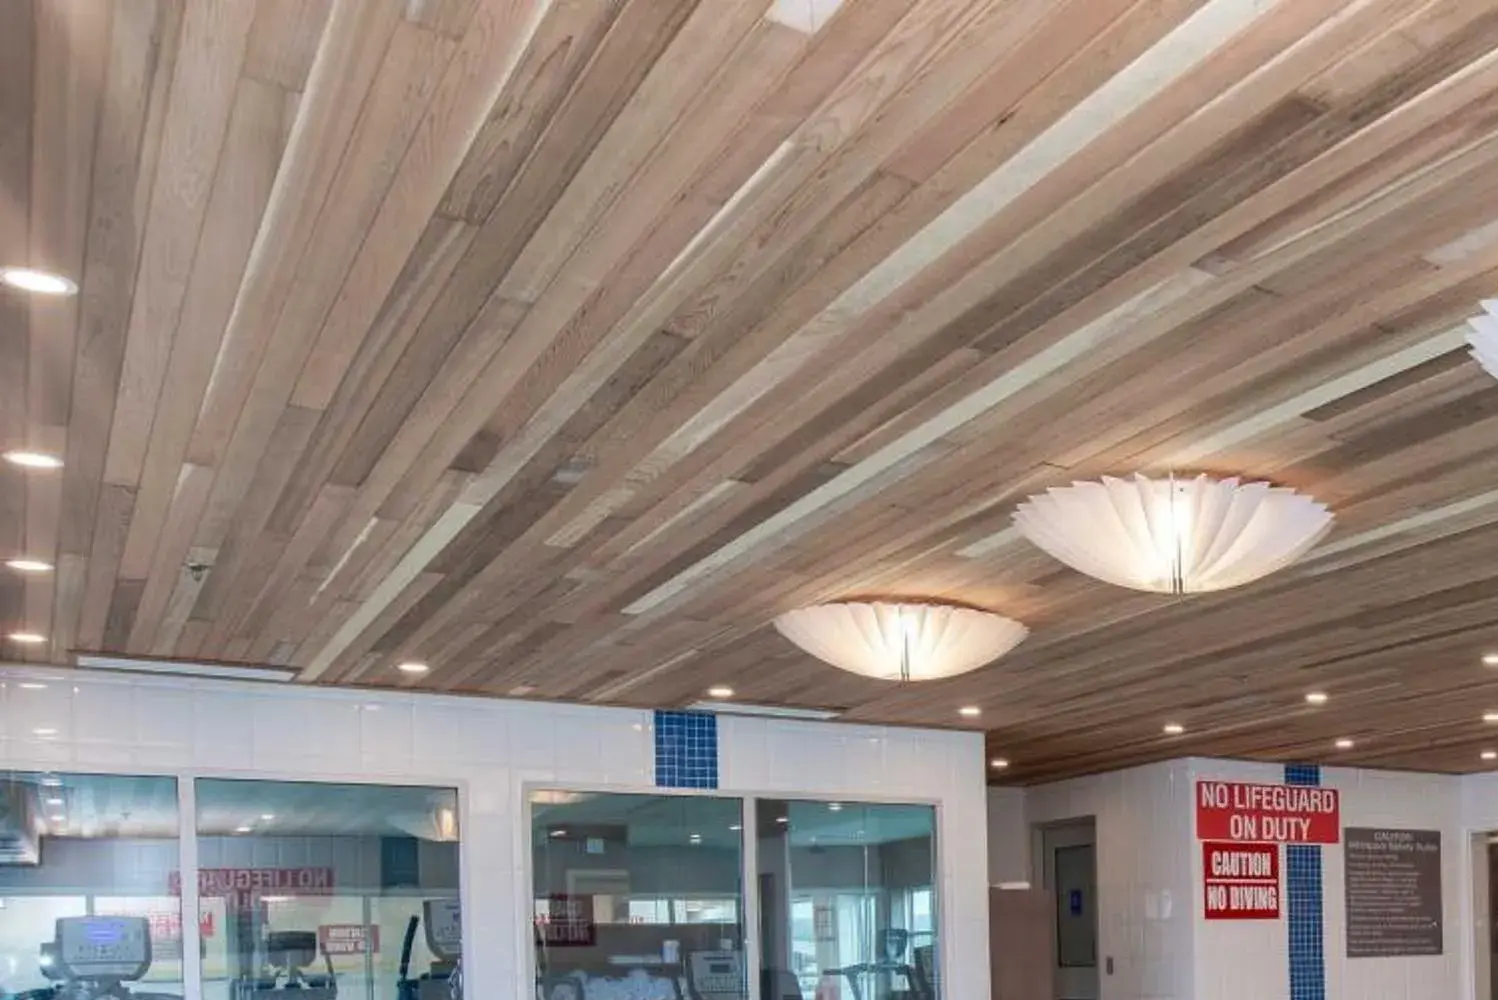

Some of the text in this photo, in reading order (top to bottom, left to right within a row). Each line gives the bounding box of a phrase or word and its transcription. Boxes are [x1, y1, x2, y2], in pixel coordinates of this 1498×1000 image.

[1202, 783, 1334, 813] NO LIFEGUARD
[1230, 815, 1311, 840] ON DUTY
[1211, 851, 1272, 876] CAUTION
[1207, 884, 1277, 910] NO DIVING
